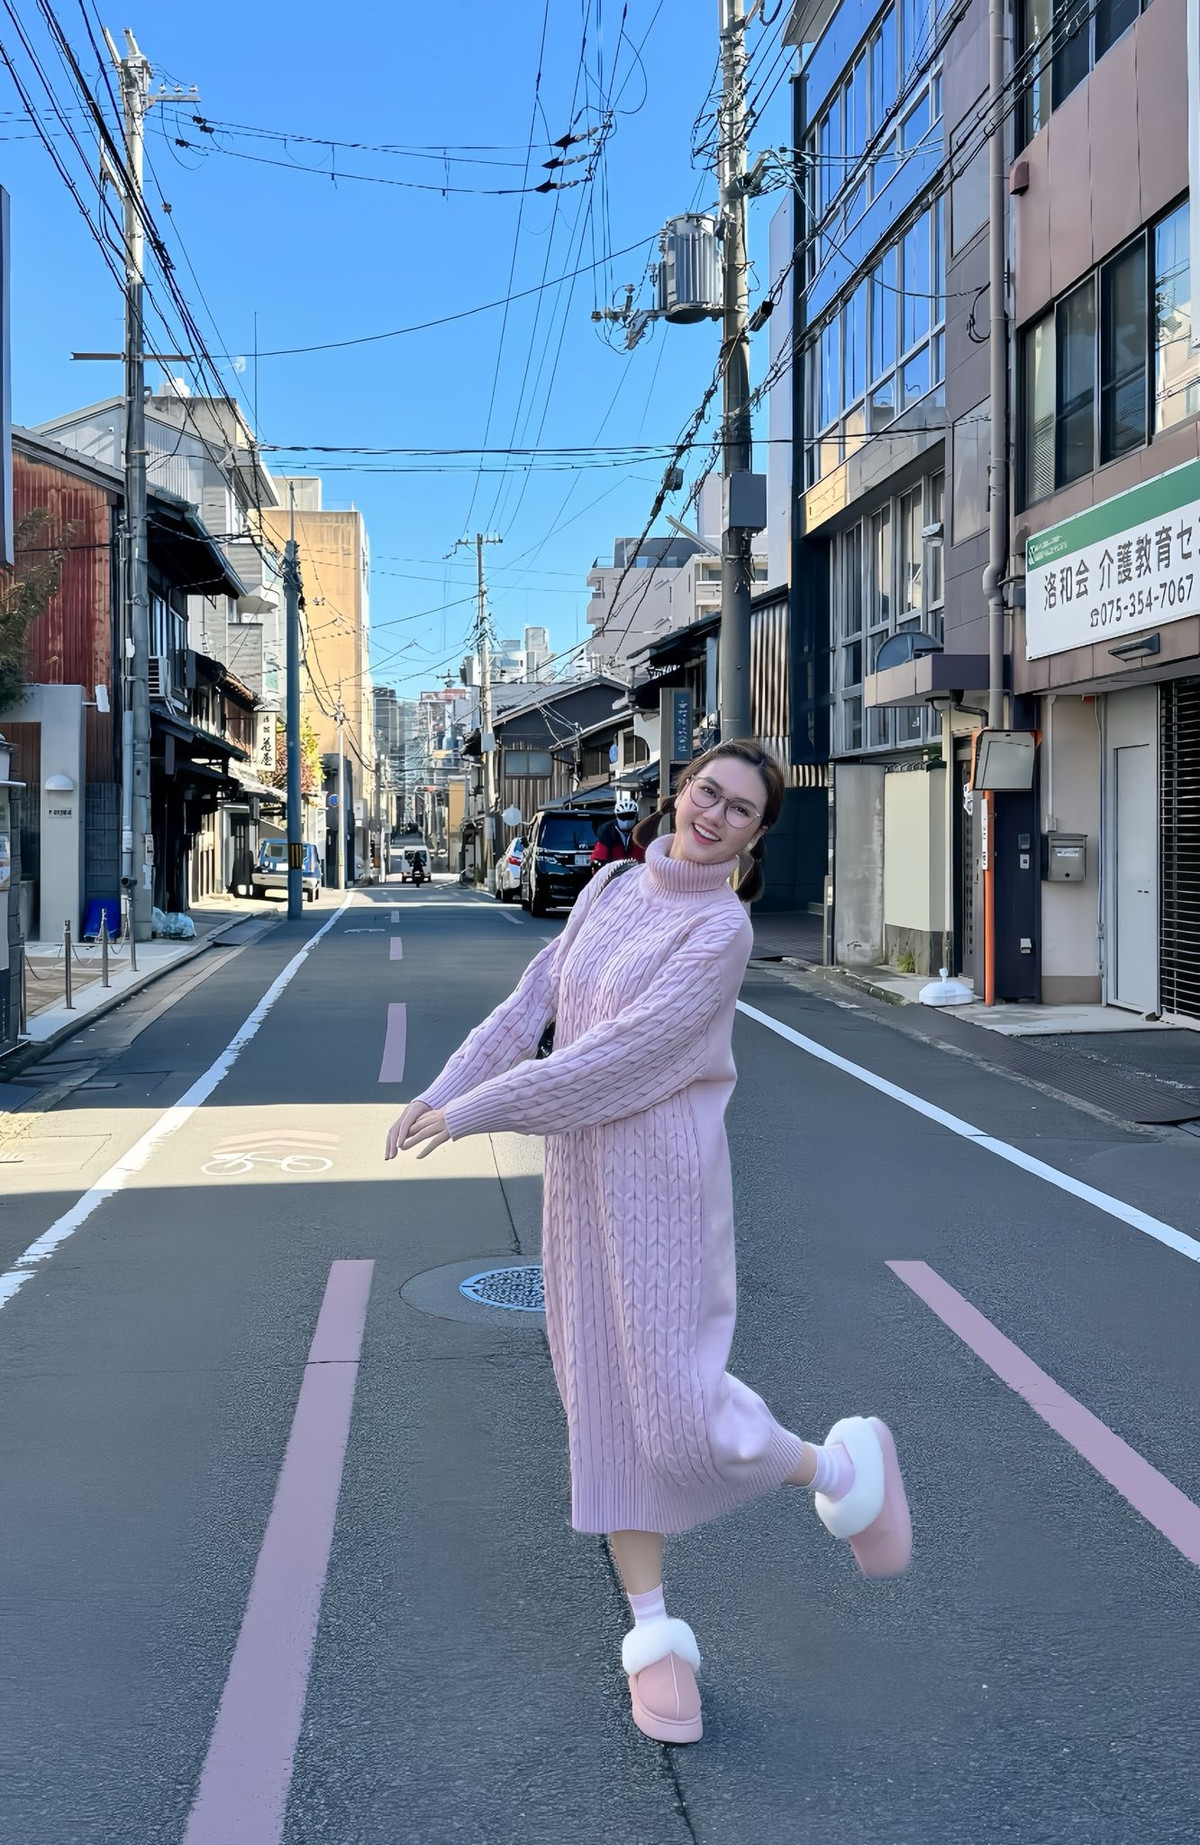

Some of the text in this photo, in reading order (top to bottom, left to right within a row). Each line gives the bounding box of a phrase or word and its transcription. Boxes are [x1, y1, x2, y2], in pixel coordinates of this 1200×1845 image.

[1044, 516, 1200, 611] 洛和会 介護教育セ
[1101, 573, 1194, 626] 075-354-7067
